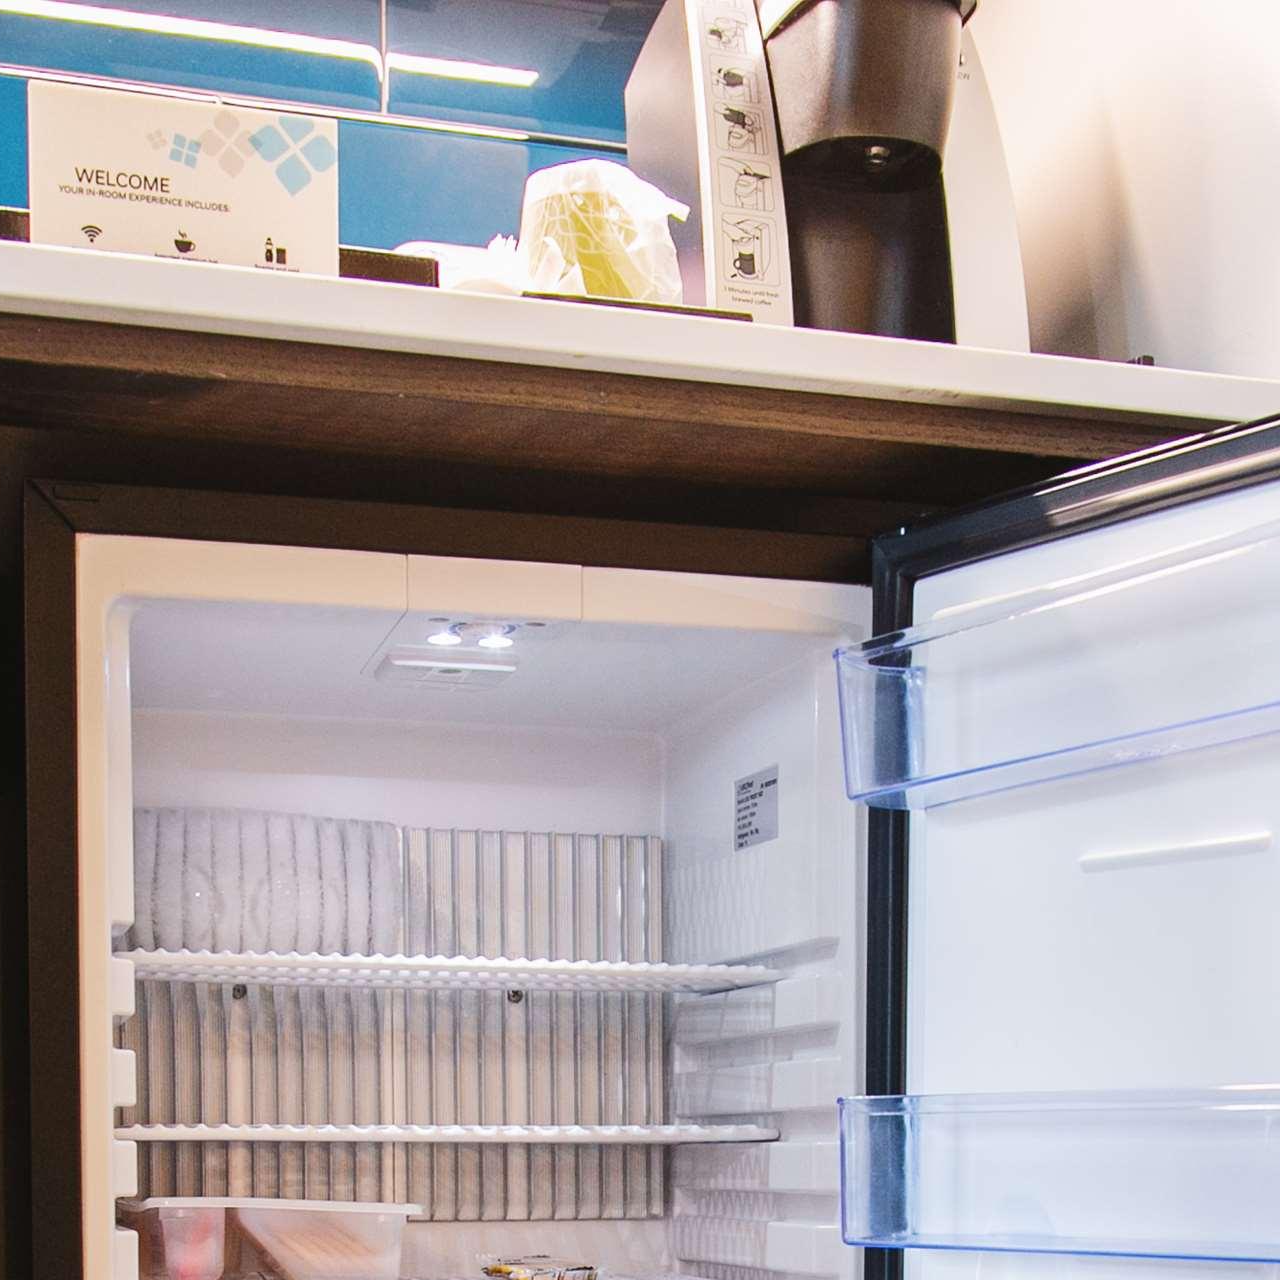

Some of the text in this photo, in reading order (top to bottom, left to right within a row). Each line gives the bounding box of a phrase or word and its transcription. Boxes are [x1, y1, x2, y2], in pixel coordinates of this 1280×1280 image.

[75, 167, 170, 192] WELCOME
[59, 185, 84, 196] YOUR
[86, 188, 127, 201] IN-ROOM
[128, 193, 183, 208] EXPERIENCE
